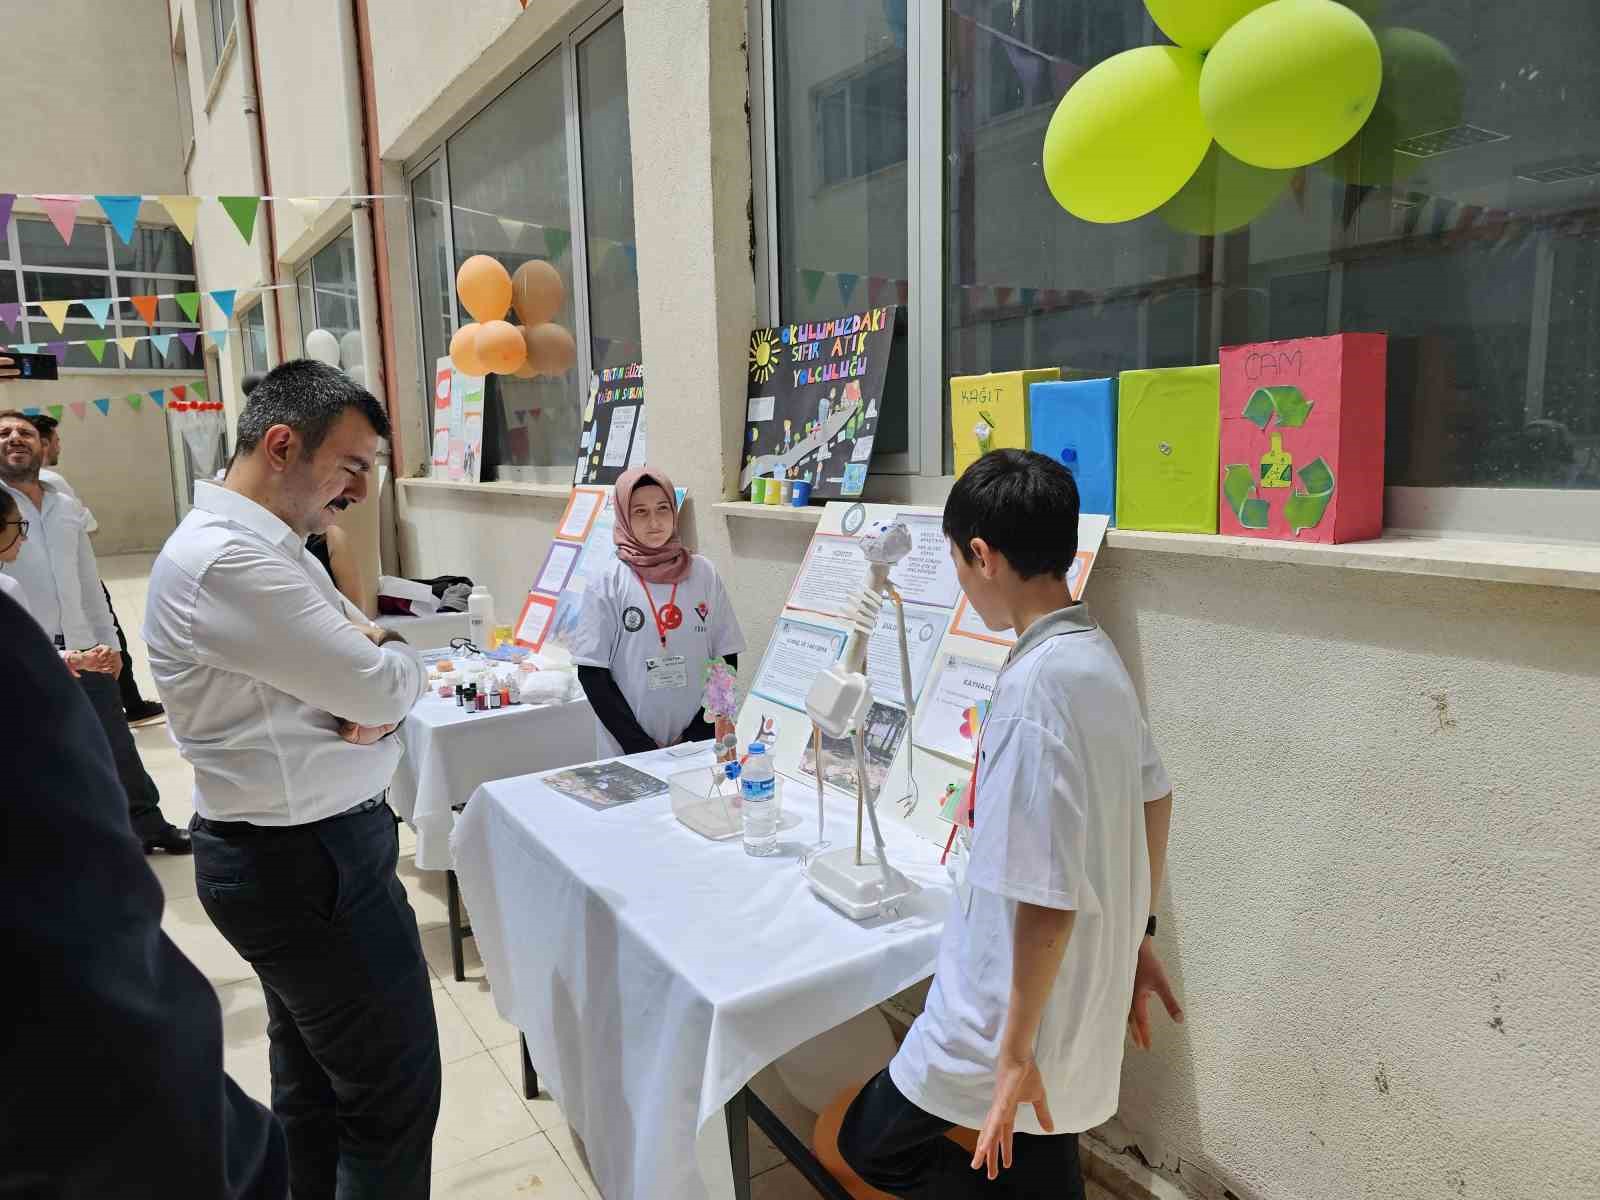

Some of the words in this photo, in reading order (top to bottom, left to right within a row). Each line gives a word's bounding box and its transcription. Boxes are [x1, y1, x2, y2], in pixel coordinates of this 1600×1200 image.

[781, 307, 887, 345] OKULUMUZDAKİ
[791, 342, 820, 362] SIFIR
[831, 332, 869, 357] ATIK
[793, 355, 868, 388] YOLCULUĞU
